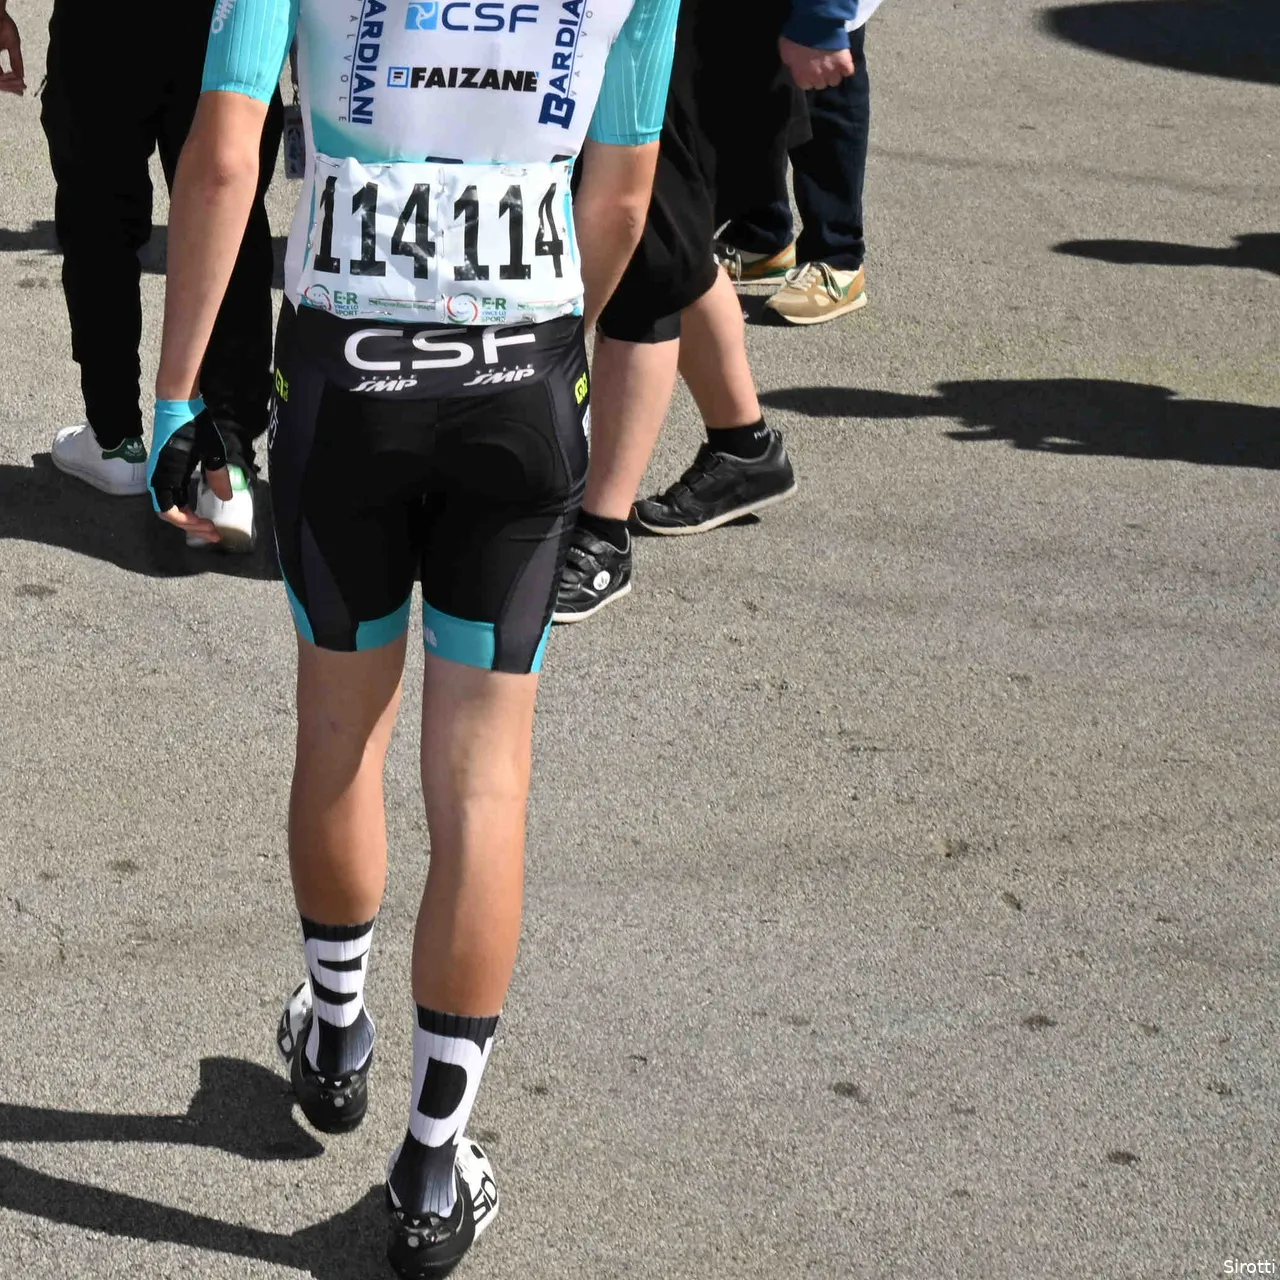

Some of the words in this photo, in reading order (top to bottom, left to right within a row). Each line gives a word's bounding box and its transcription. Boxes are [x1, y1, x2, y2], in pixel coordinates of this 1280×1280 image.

[441, 2, 540, 33] CSF
[313, 175, 437, 279] 114
[453, 183, 565, 281] 114
[344, 325, 536, 370] CSF
[464, 368, 535, 387] SMP
